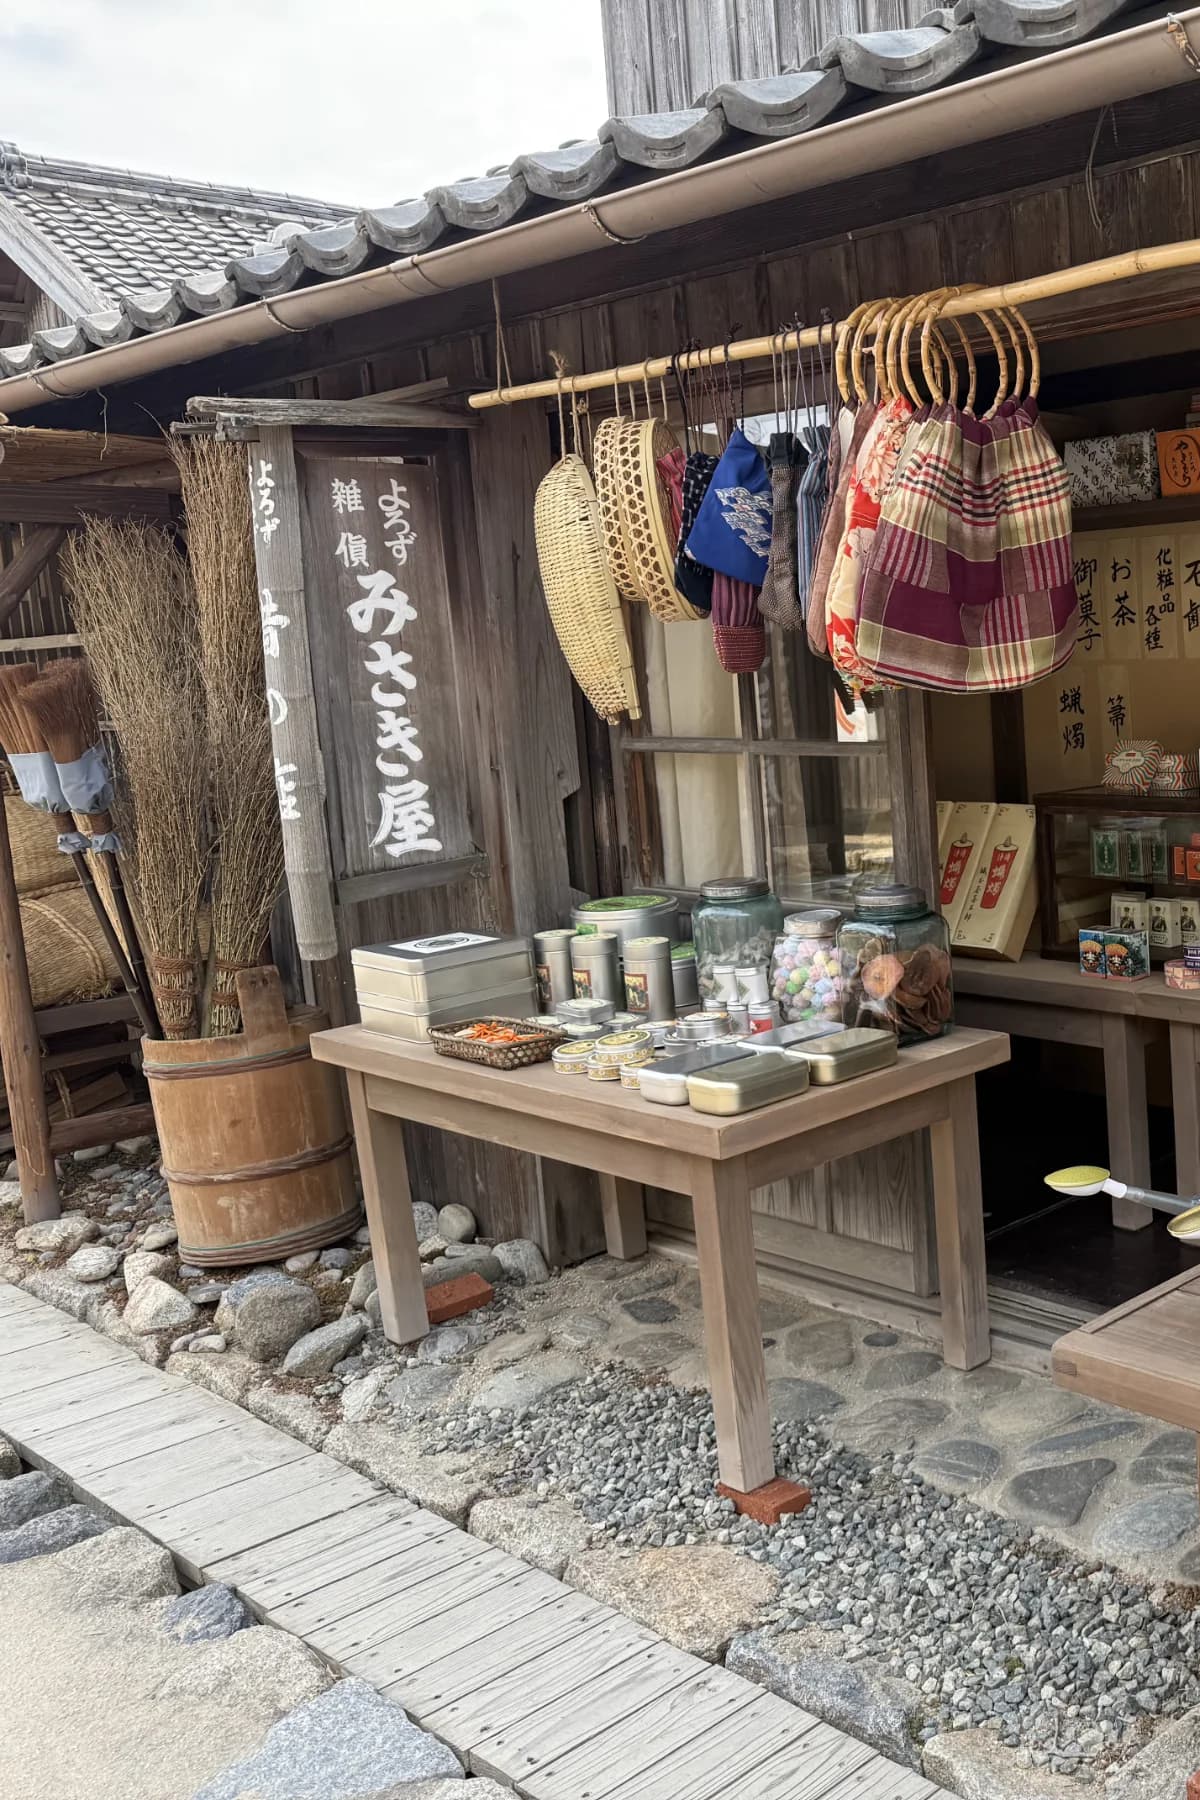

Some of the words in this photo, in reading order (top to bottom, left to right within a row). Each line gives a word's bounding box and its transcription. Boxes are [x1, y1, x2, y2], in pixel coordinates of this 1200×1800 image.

[256, 459, 281, 546] よろず
[377, 478, 418, 567] よろず
[1072, 557, 1102, 651] 御菓子
[1110, 555, 1137, 628] お茶
[1155, 547, 1175, 614] 化粧品
[1143, 604, 1164, 653] 各種
[346, 568, 443, 858] みさき屋
